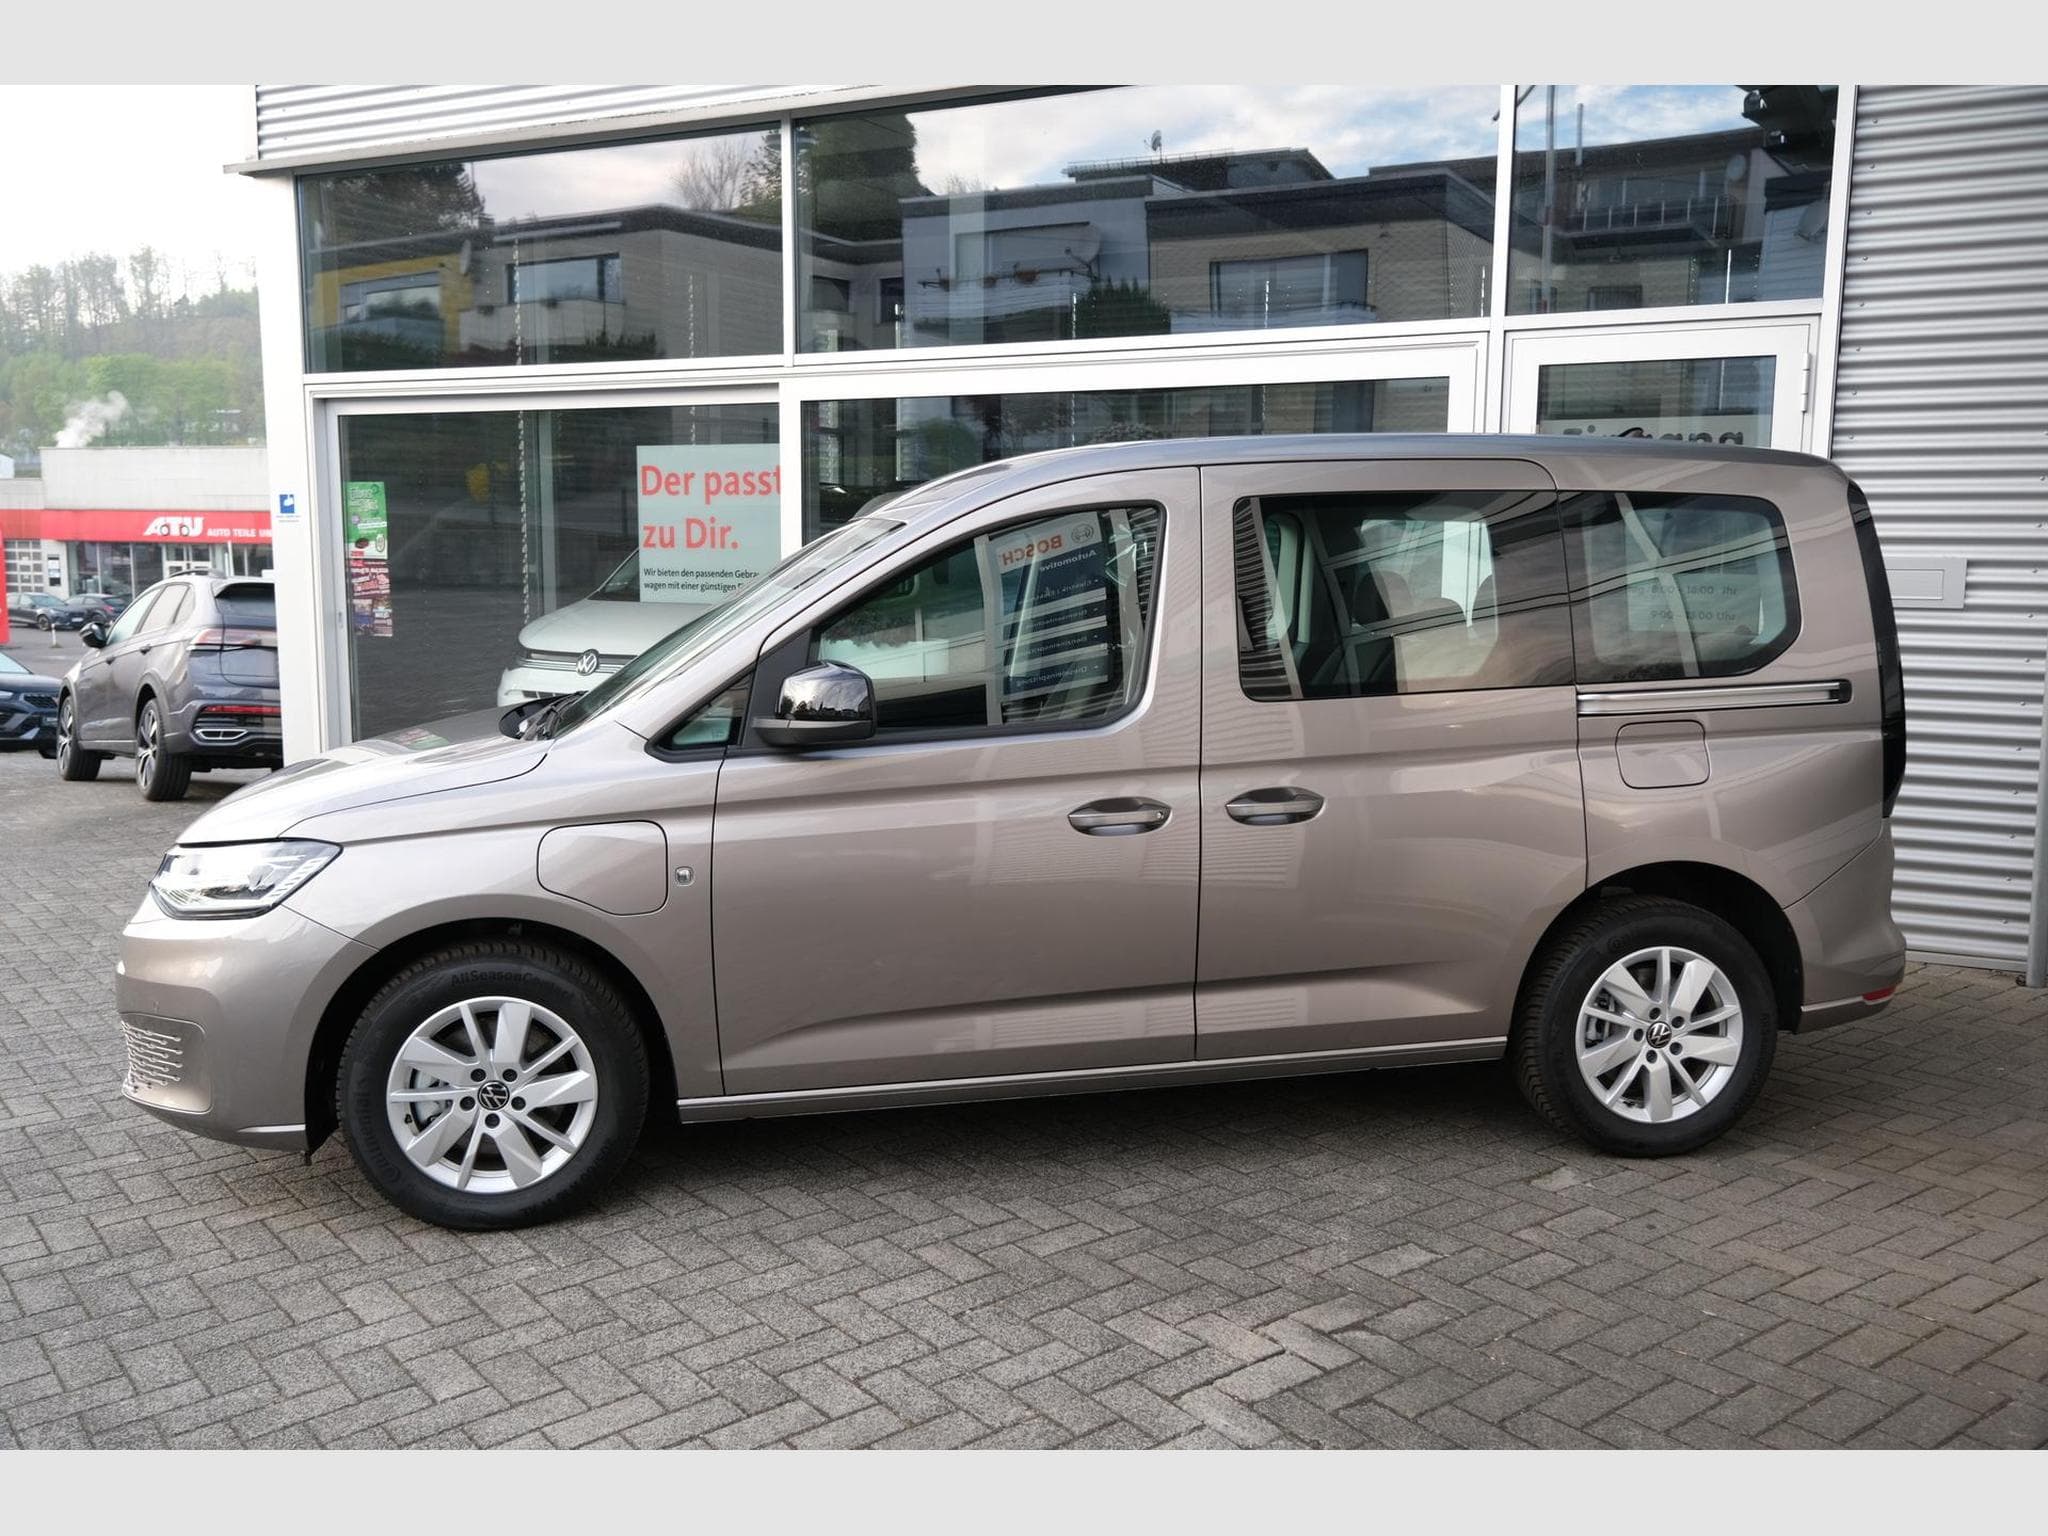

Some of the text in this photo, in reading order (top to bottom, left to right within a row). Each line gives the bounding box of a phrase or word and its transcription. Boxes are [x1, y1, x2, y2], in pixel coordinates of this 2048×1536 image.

[641, 464, 781, 505] Der passt
[143, 516, 204, 537] ATU
[207, 528, 231, 537] AUTO
[232, 528, 256, 537] TEILE
[643, 516, 739, 549] zu Dir.
[644, 568, 656, 577] Wir
[657, 568, 680, 577] bieten
[681, 568, 694, 578] den
[695, 569, 734, 579] passenden
[644, 582, 666, 592] wagen
[668, 582, 680, 590] mit
[681, 582, 699, 590] einer
[700, 582, 737, 593] günstigen
